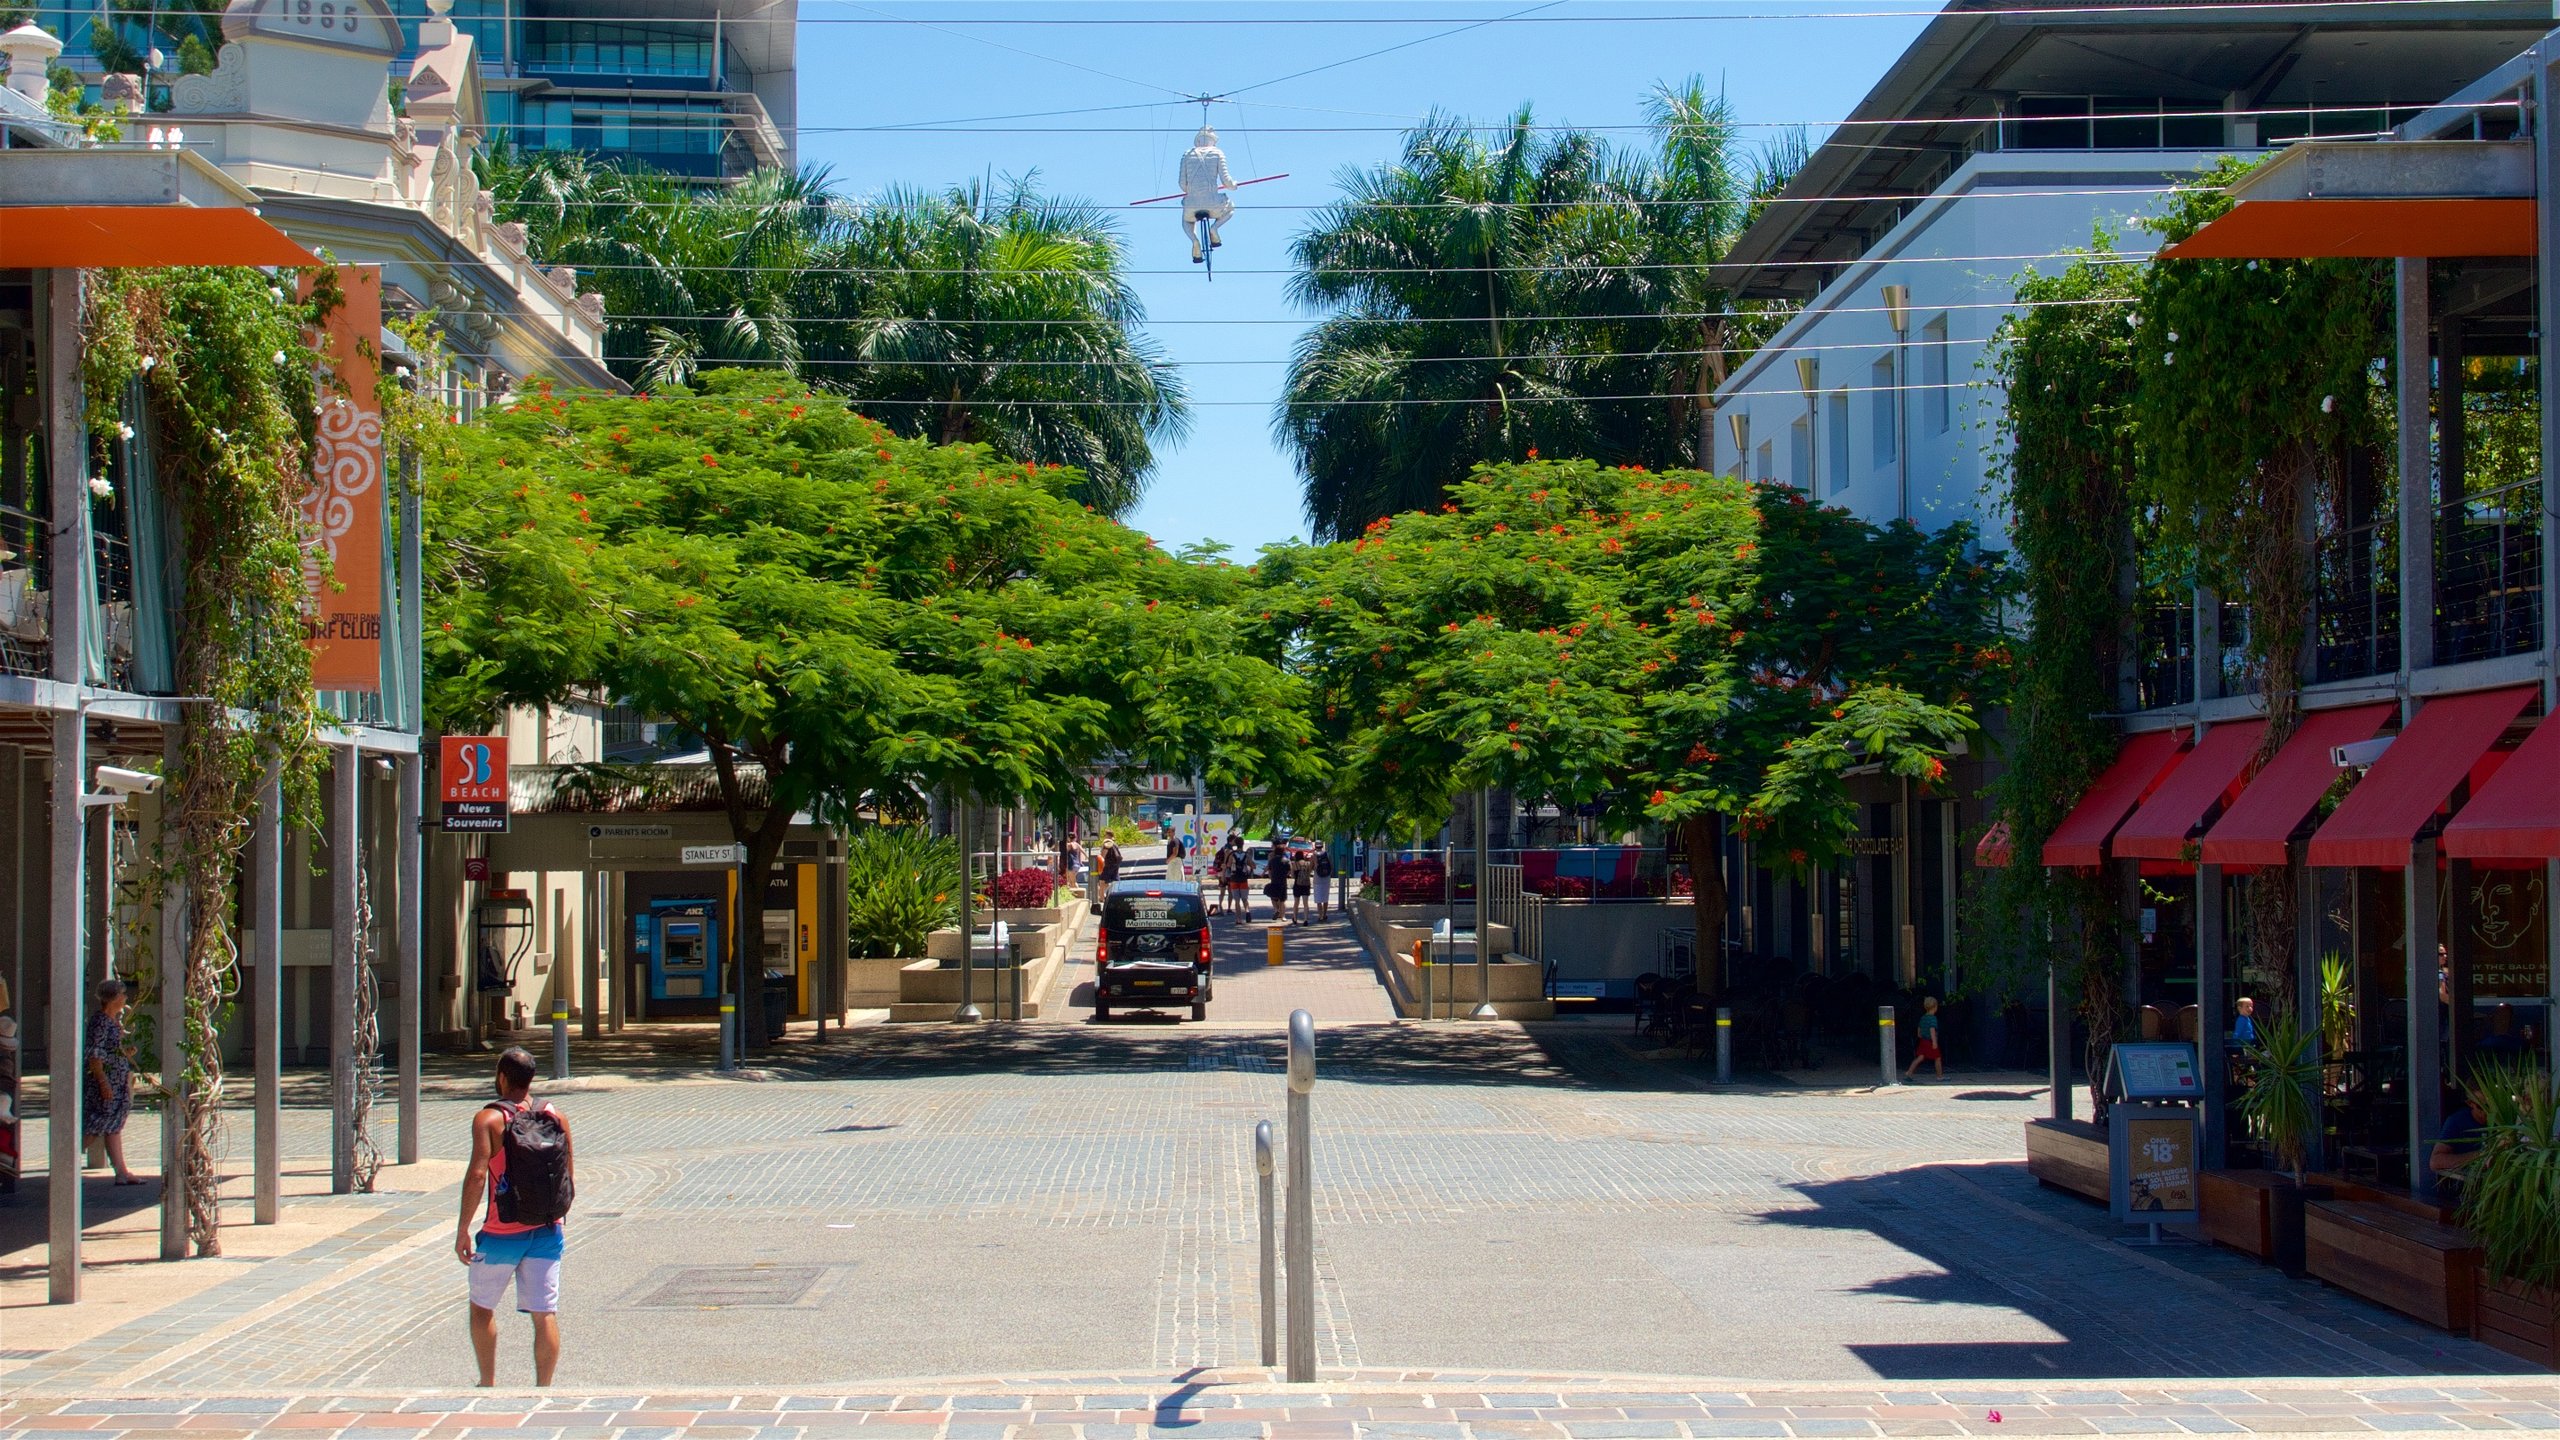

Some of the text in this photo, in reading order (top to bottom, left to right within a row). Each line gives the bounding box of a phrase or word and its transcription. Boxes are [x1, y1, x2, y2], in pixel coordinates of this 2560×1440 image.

[282, 0, 358, 33] 1885
[331, 612, 381, 623] SOUTH BANK
[340, 621, 381, 640] CLUB
[450, 787, 500, 798] BEACH
[459, 803, 491, 814] News
[446, 816, 503, 828] Souvenirs
[604, 828, 669, 836] PARENTS ROOM
[1854, 837, 1889, 855] CHOCOLATE
[685, 850, 720, 861] STANLEY
[770, 879, 788, 887] ATM
[685, 907, 705, 916] ANZ
[2136, 1167, 2188, 1180] LUNCH BURGER
[2148, 1182, 2165, 1190] SOFT
